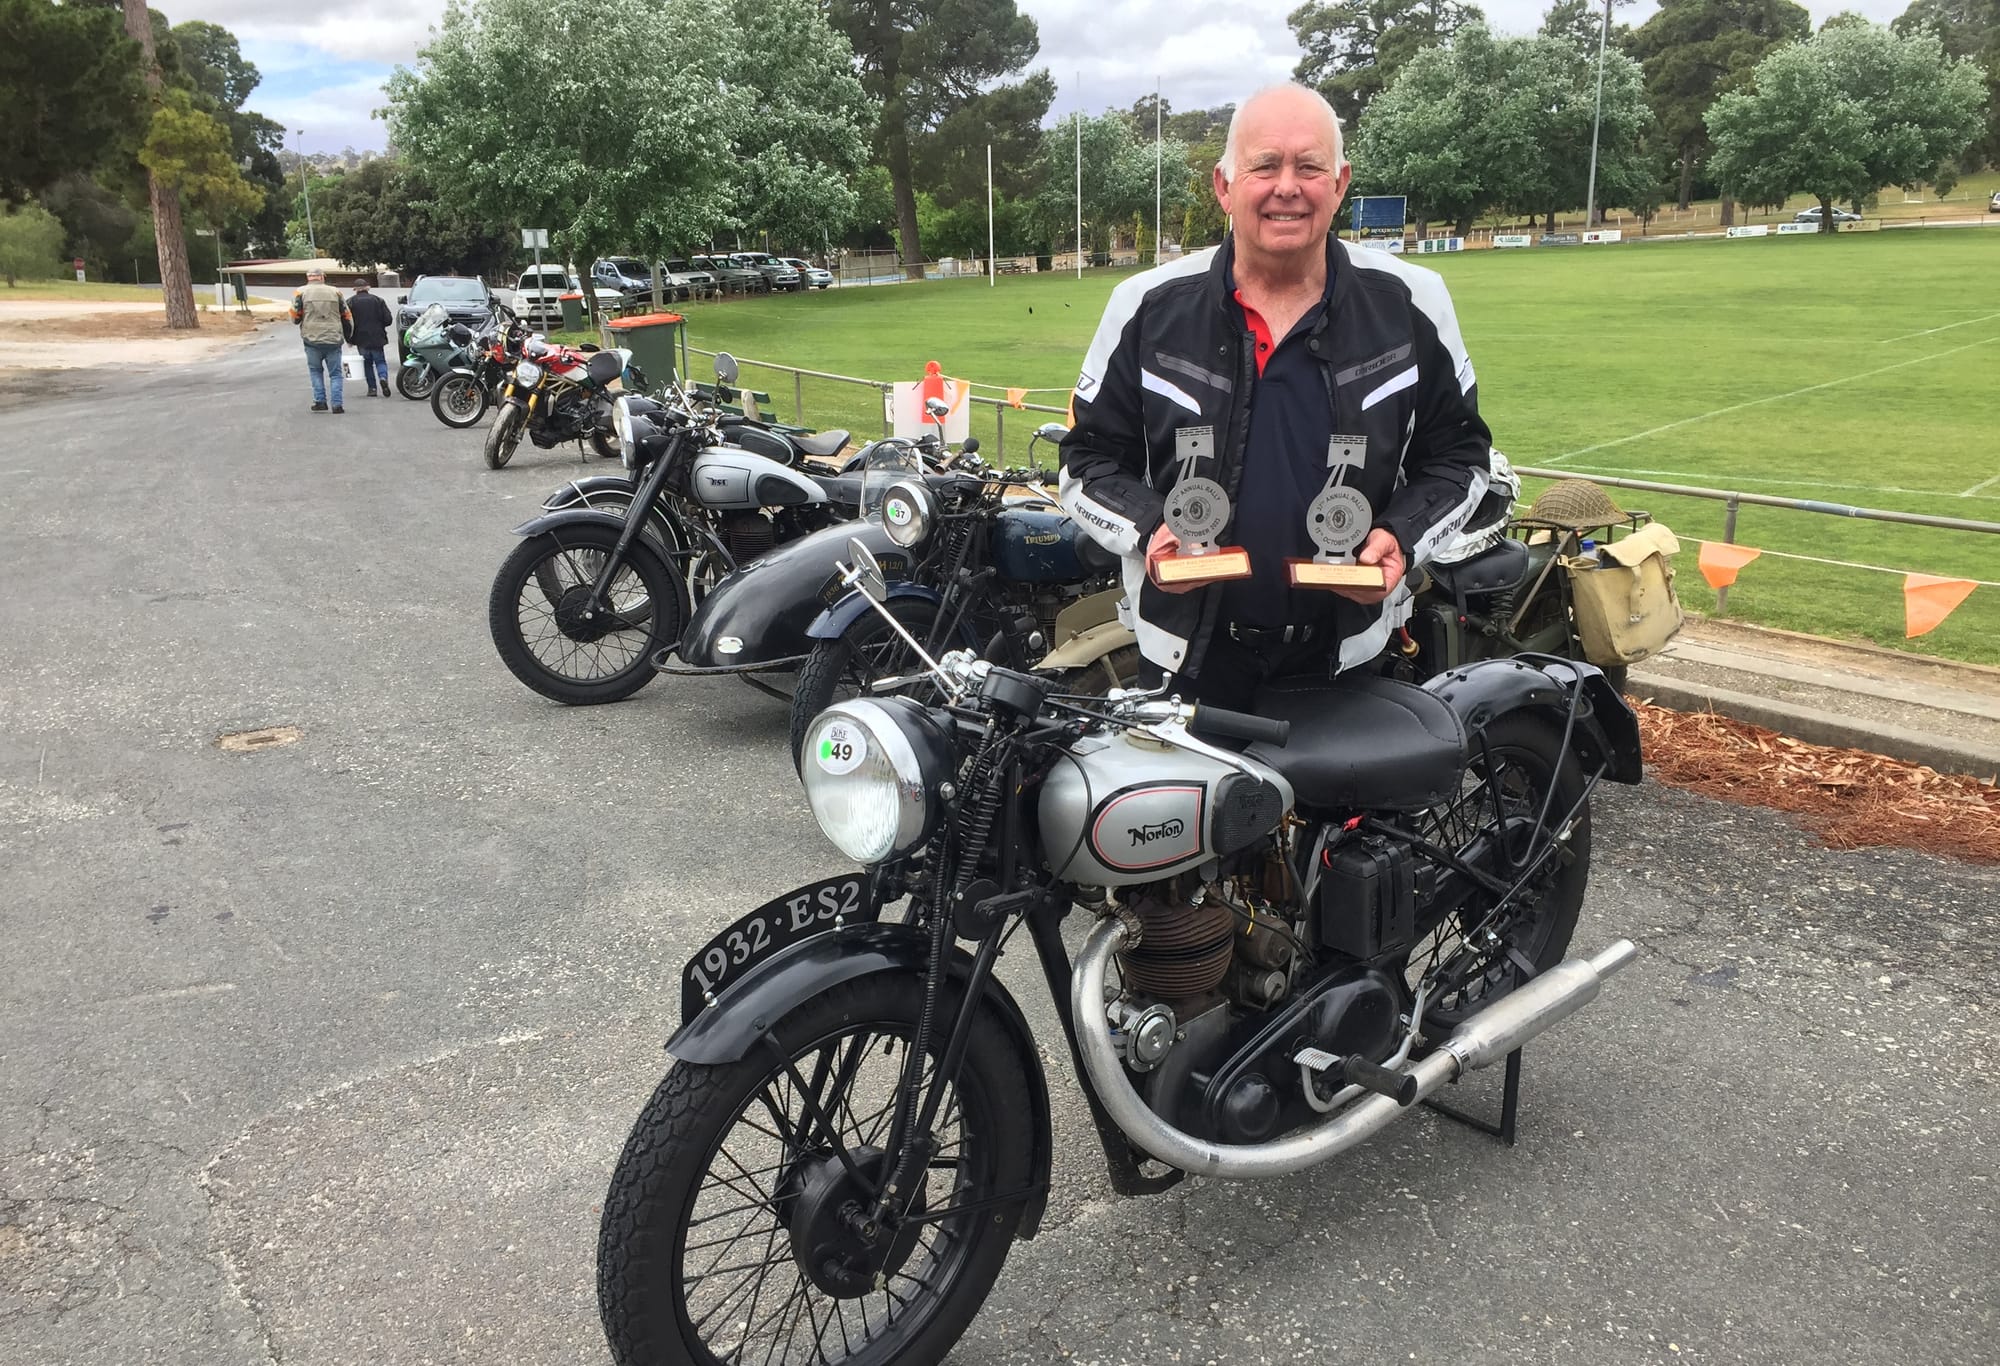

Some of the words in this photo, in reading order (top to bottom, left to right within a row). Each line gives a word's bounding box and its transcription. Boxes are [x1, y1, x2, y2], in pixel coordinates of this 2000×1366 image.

[1181, 484, 1204, 496] ANNUAL
[1205, 486, 1221, 501] RALLY
[1326, 493, 1350, 503] ANNUAL
[1351, 495, 1365, 512] RALLY
[895, 509, 905, 519] 37
[1023, 533, 1061, 546] TRIUMPH
[1182, 528, 1210, 537] OCTOBER
[1323, 537, 1350, 546] OCTOBER
[831, 742, 853, 761] 49
[1128, 818, 1184, 847] Norton
